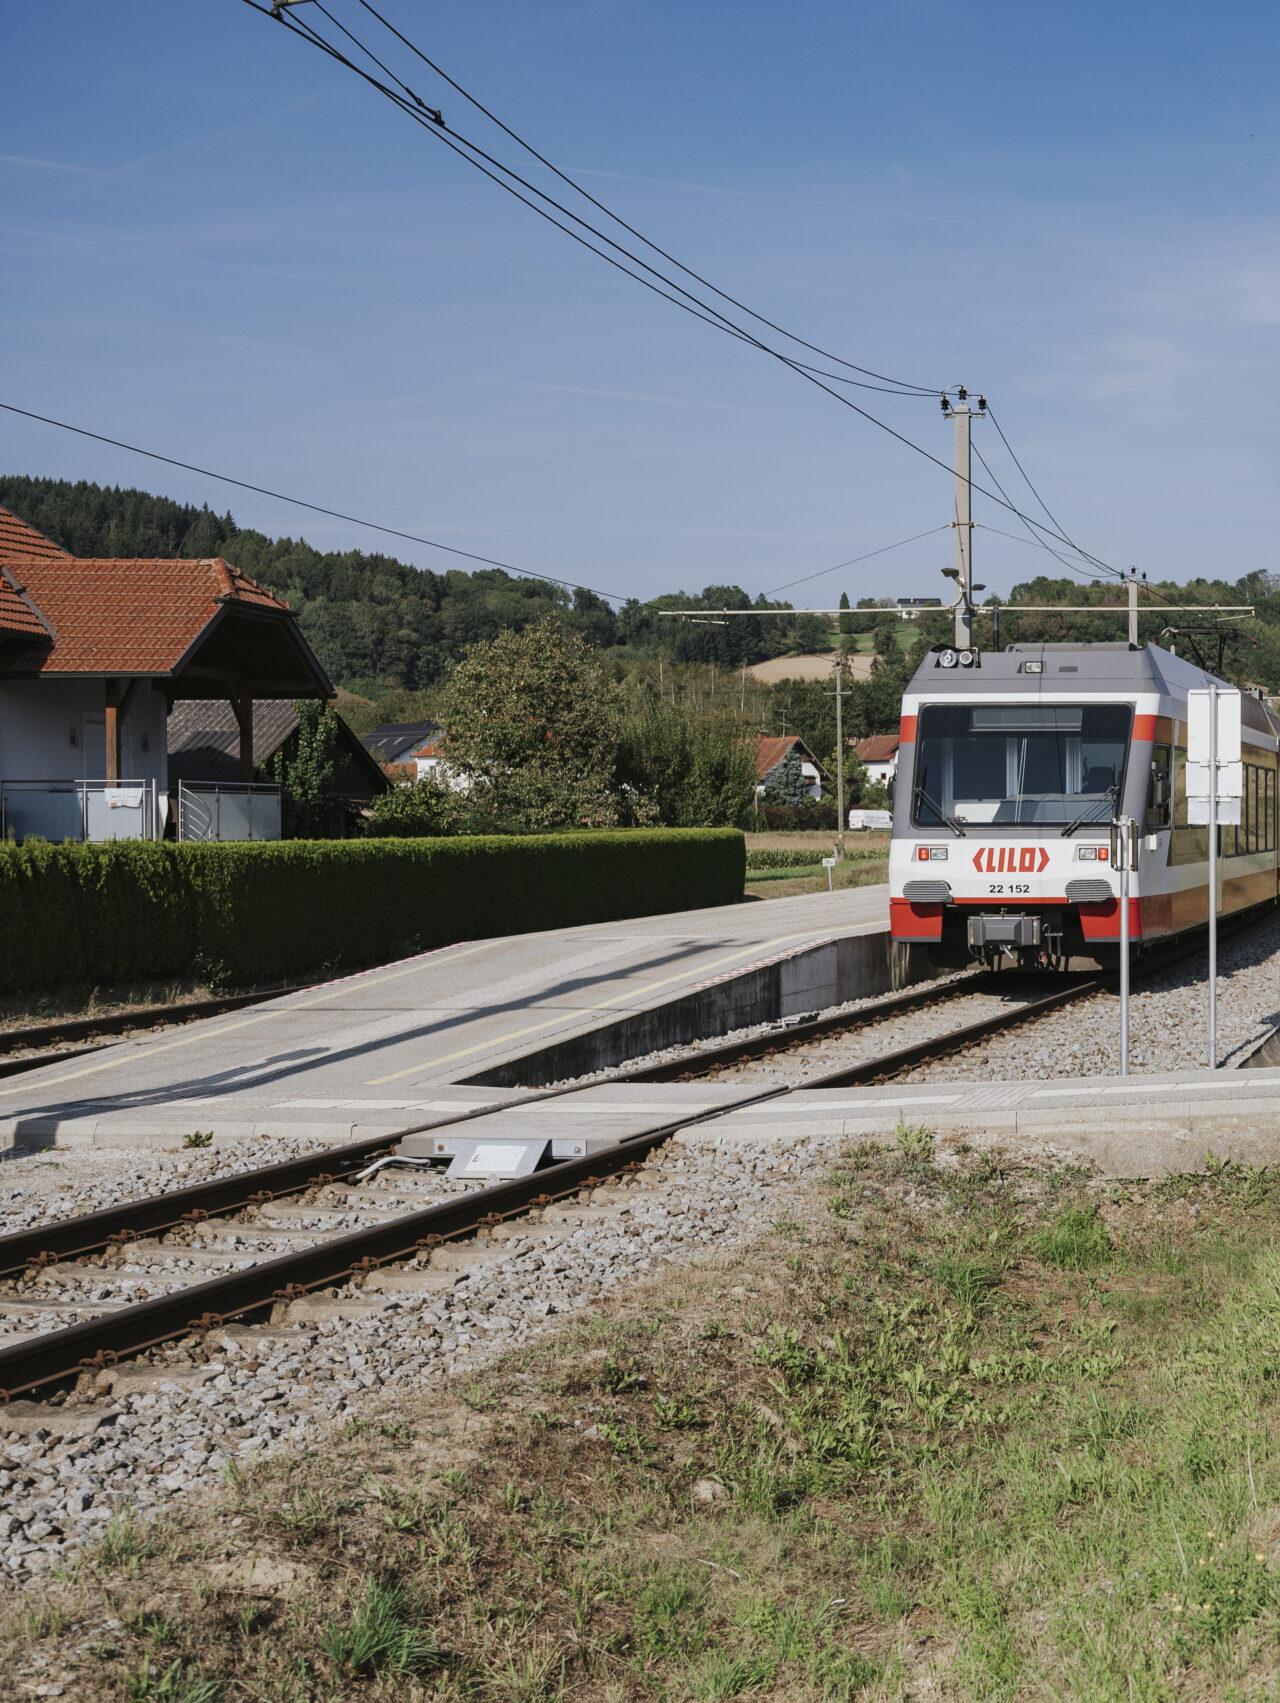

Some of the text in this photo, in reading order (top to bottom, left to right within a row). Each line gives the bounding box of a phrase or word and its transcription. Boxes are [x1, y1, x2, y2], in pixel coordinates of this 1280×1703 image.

[985, 847, 1036, 873] LILO
[989, 884, 1030, 894] 22 152
